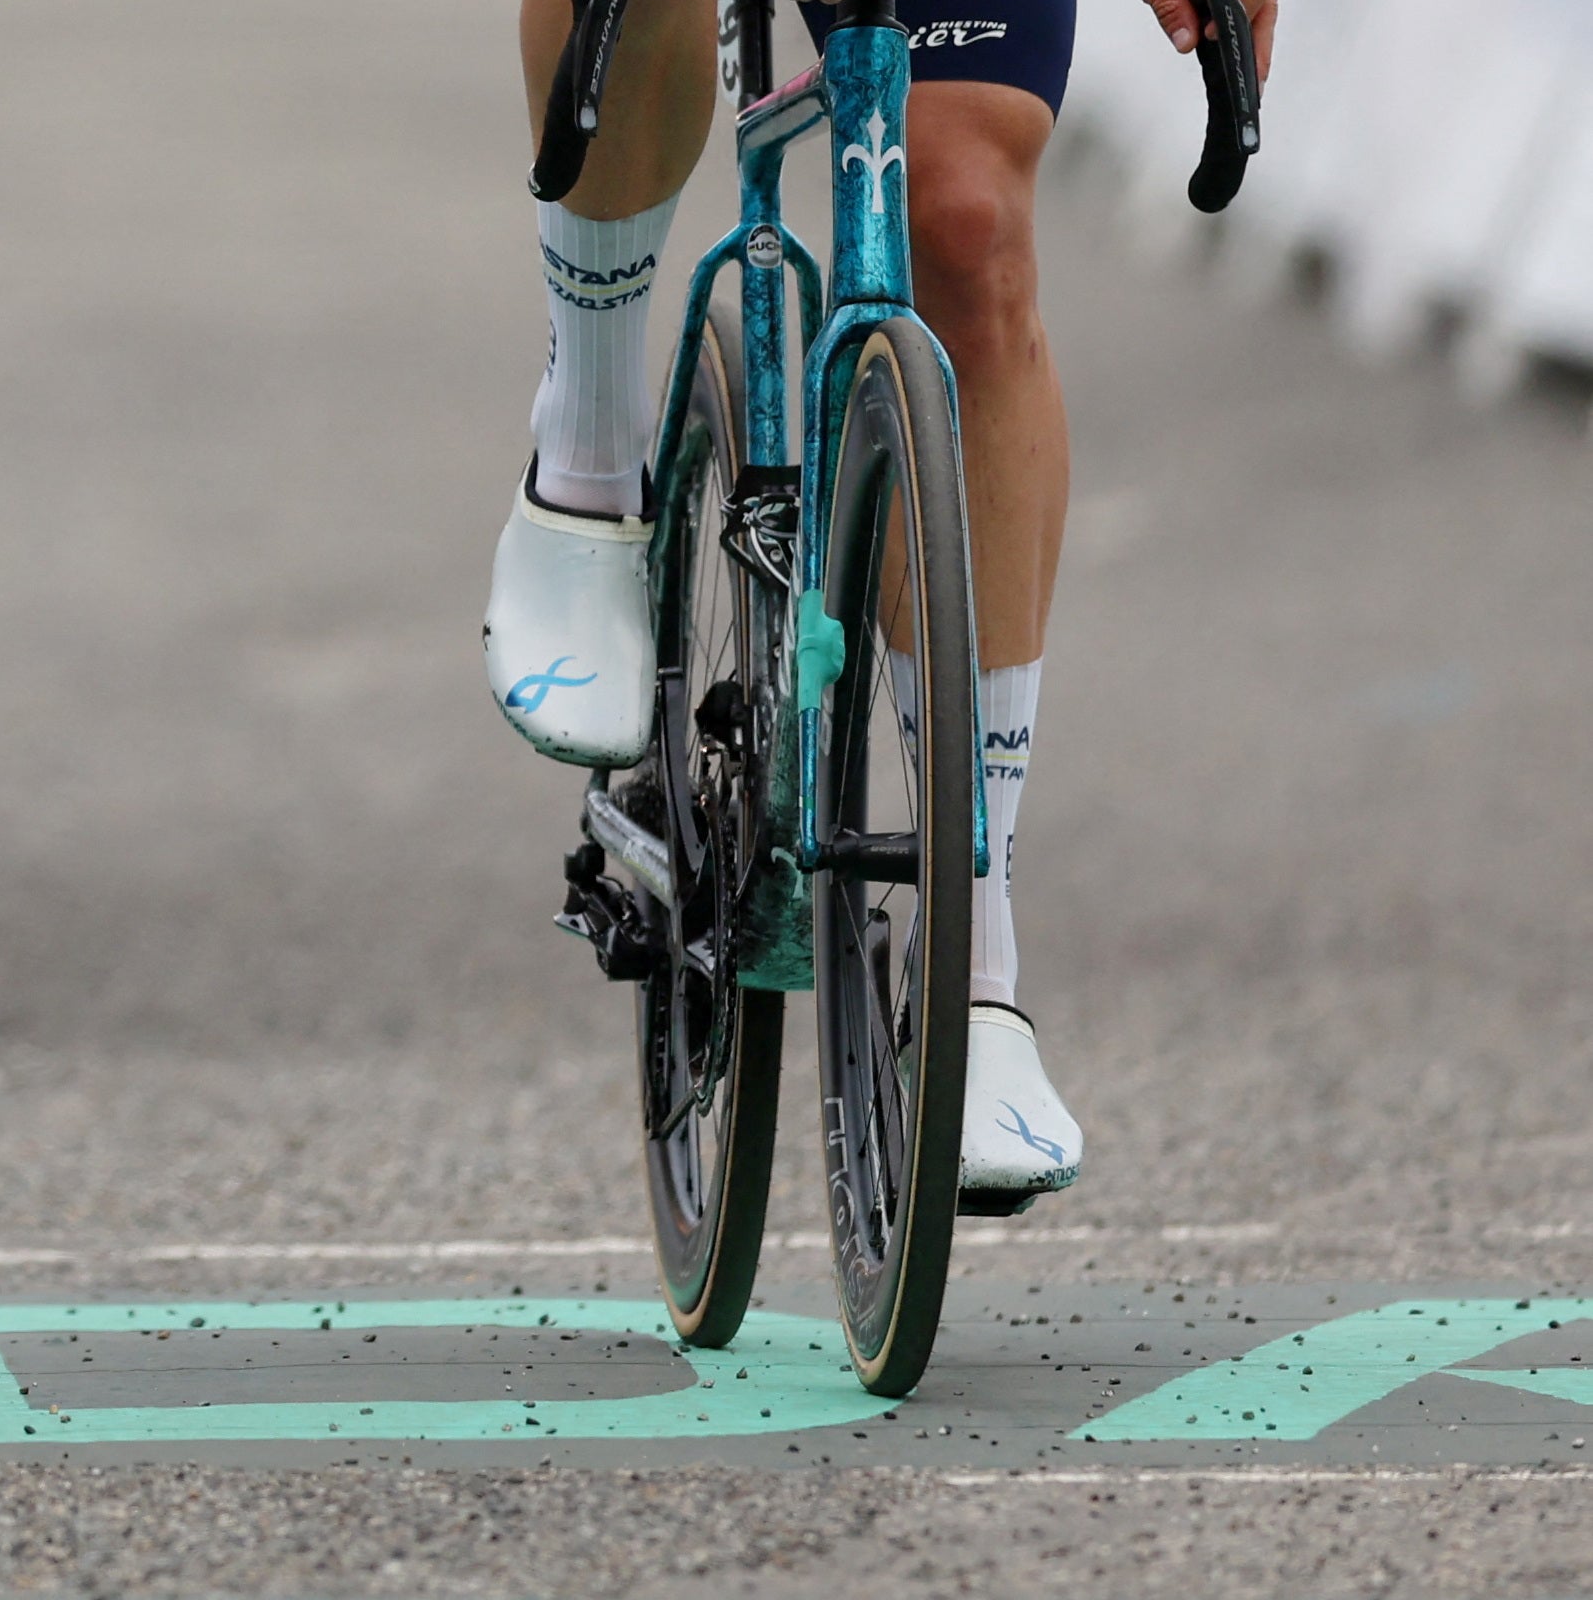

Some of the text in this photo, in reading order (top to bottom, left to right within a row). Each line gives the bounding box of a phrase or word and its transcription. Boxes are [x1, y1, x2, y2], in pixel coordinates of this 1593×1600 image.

[931, 20, 1008, 31] TRIESTINA
[1224, 5, 1251, 113] DURA-ACE
[544, 242, 656, 286] STANA
[548, 276, 651, 311] ZAQSTAN
